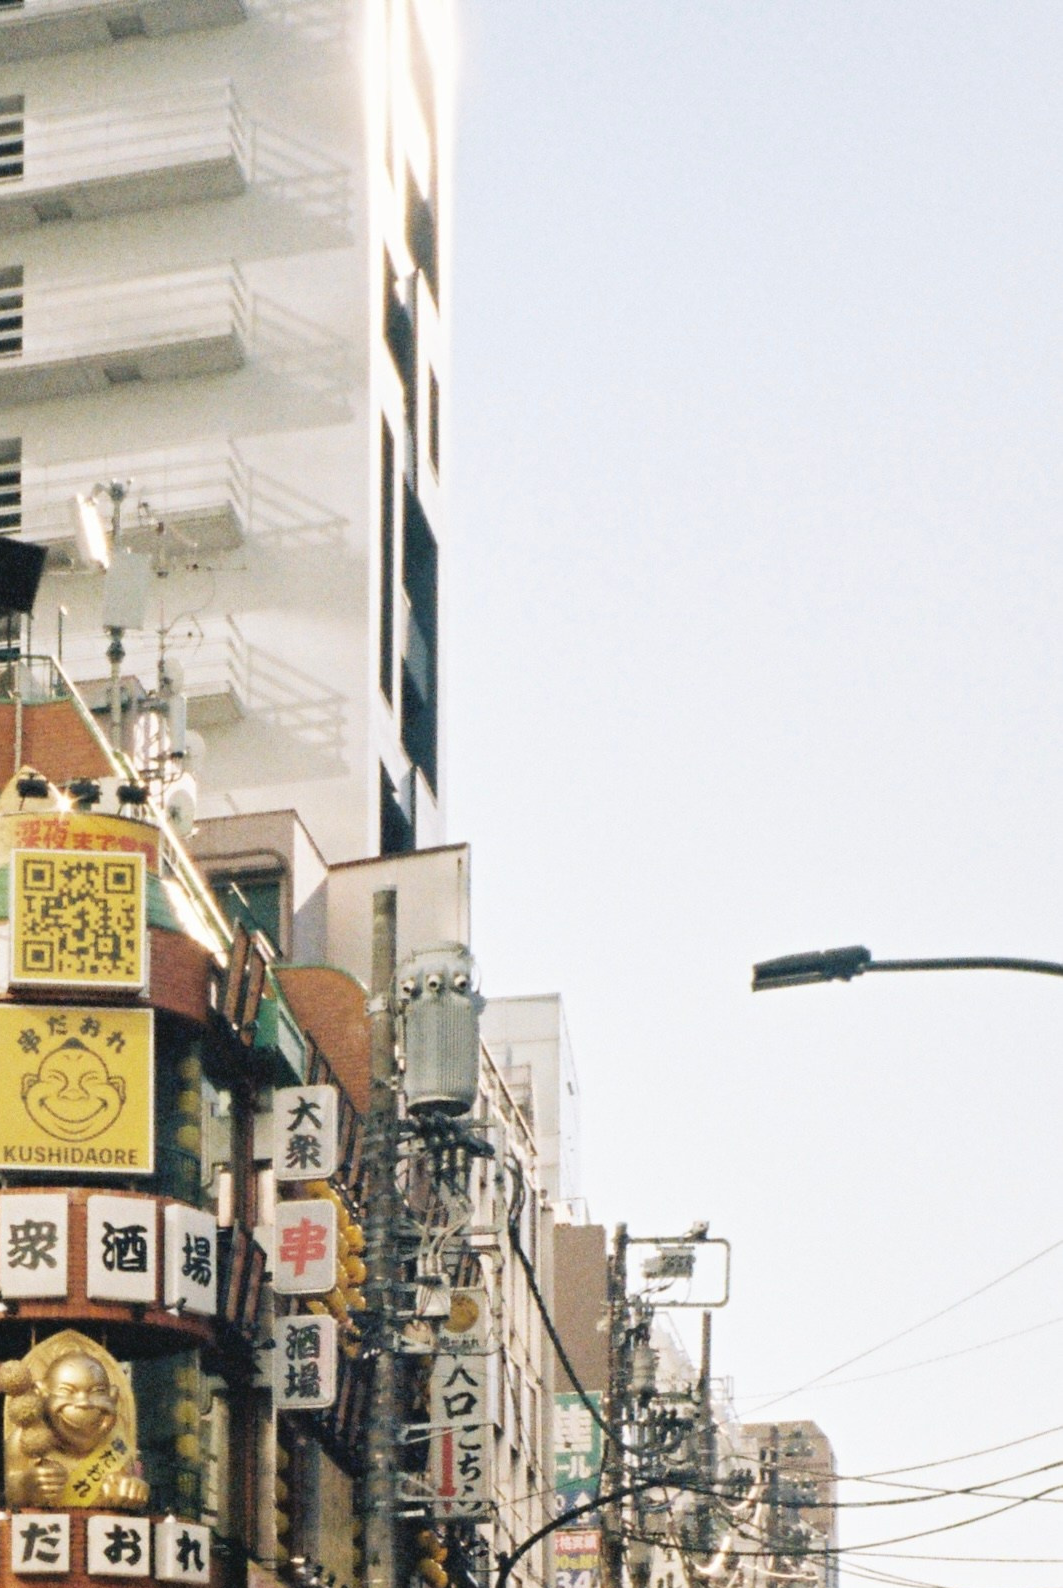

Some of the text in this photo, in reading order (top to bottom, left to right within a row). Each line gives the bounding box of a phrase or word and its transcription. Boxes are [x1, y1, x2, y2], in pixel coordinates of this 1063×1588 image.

[18, 1016, 127, 1054] 串だおれ
[3, 1145, 138, 1167] KUSHIDAORE
[286, 1096, 323, 1169] 大衆
[279, 1216, 328, 1277] 串
[285, 1322, 324, 1399] 酒場
[72, 1435, 128, 1499] 串だおれ
